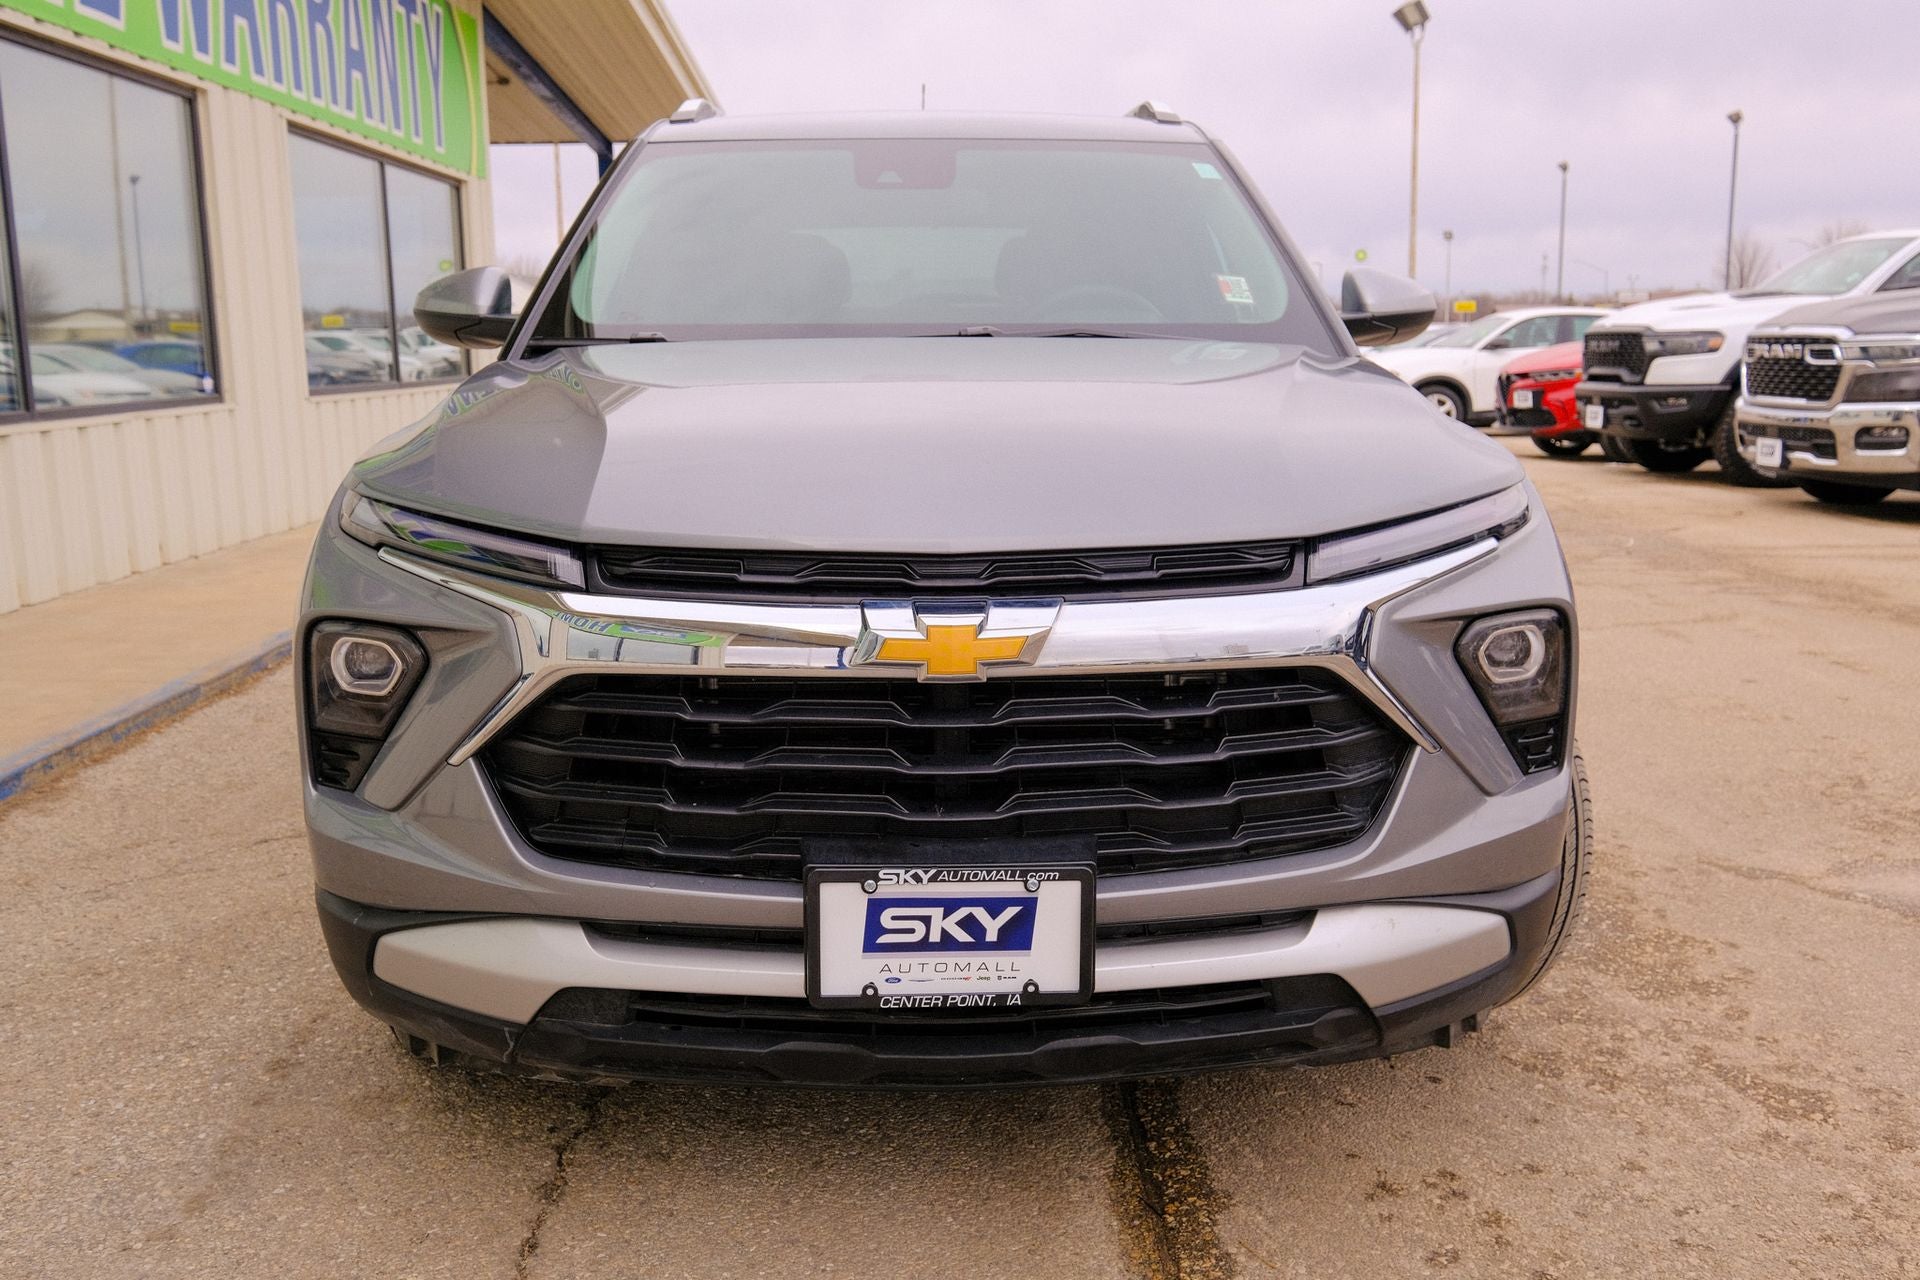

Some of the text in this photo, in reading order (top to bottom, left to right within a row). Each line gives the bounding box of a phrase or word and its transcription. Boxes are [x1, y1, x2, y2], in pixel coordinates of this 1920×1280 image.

[1755, 343, 1803, 359] RAM
[878, 868, 1059, 885] SKY AUTOMALL.com
[875, 906, 1024, 943] SKY
[879, 962, 1021, 974] AUTOMALL
[879, 993, 1022, 1009] CENTER POINT, IA
